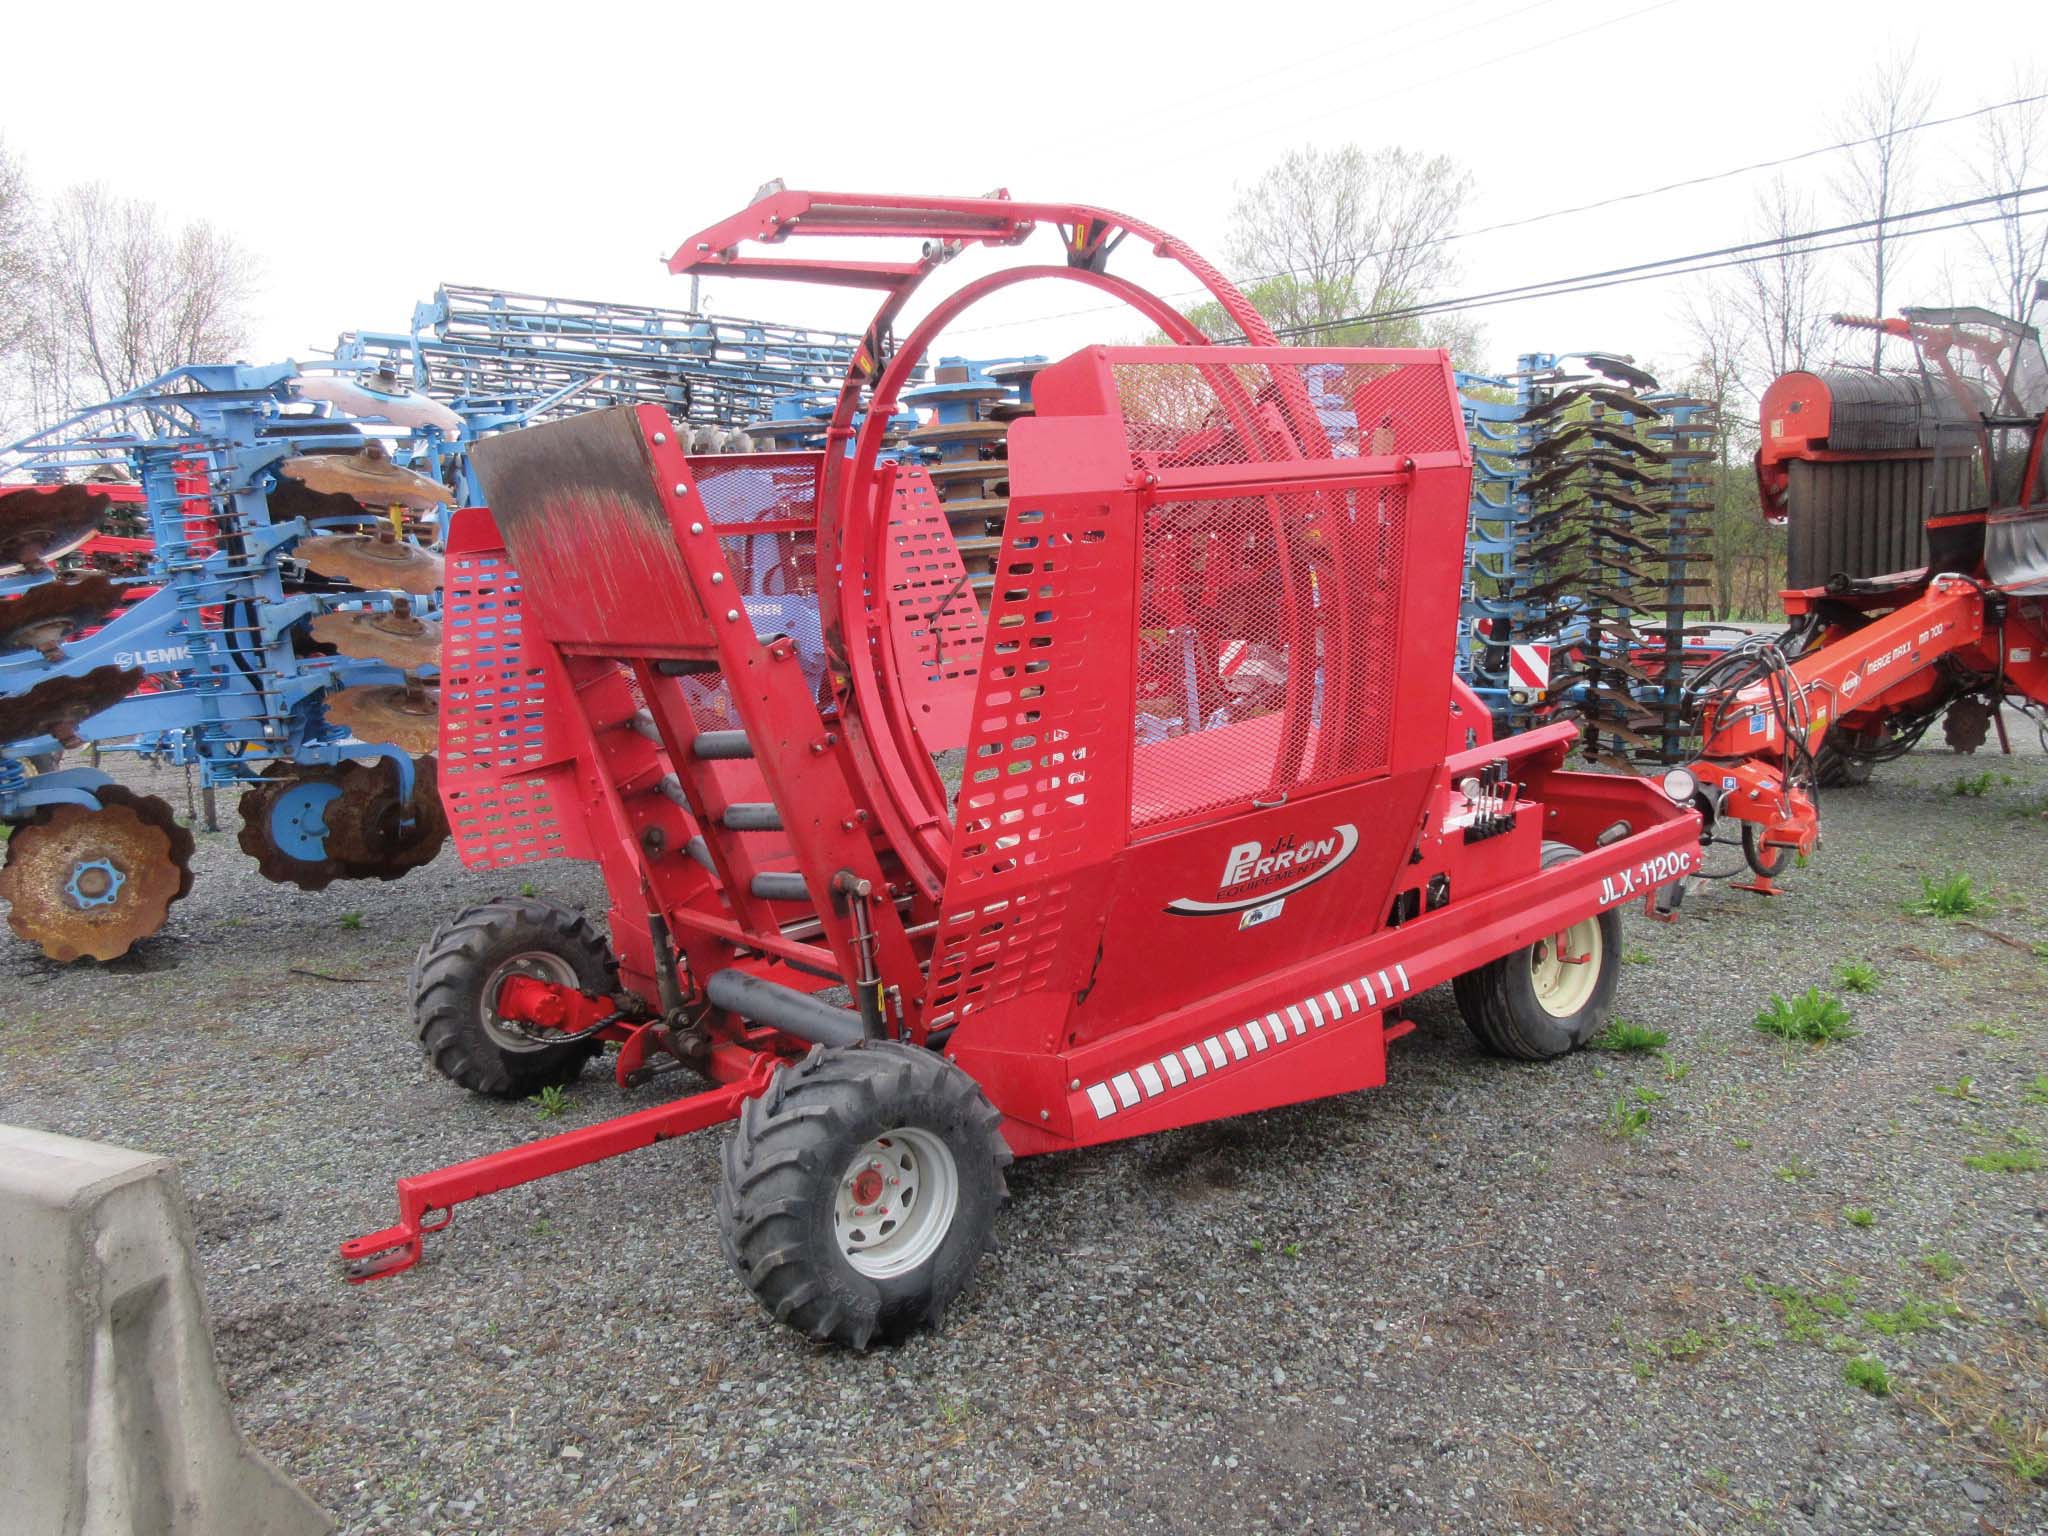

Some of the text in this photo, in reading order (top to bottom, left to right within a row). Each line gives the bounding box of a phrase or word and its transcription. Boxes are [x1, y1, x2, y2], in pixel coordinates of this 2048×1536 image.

[1867, 651, 1892, 675] MERGE
[1893, 640, 1912, 660] MAXX
[1930, 623, 1943, 639] 700
[1216, 858, 1328, 900] EQUIPEMENTS
[1220, 837, 1336, 888] PERRON
